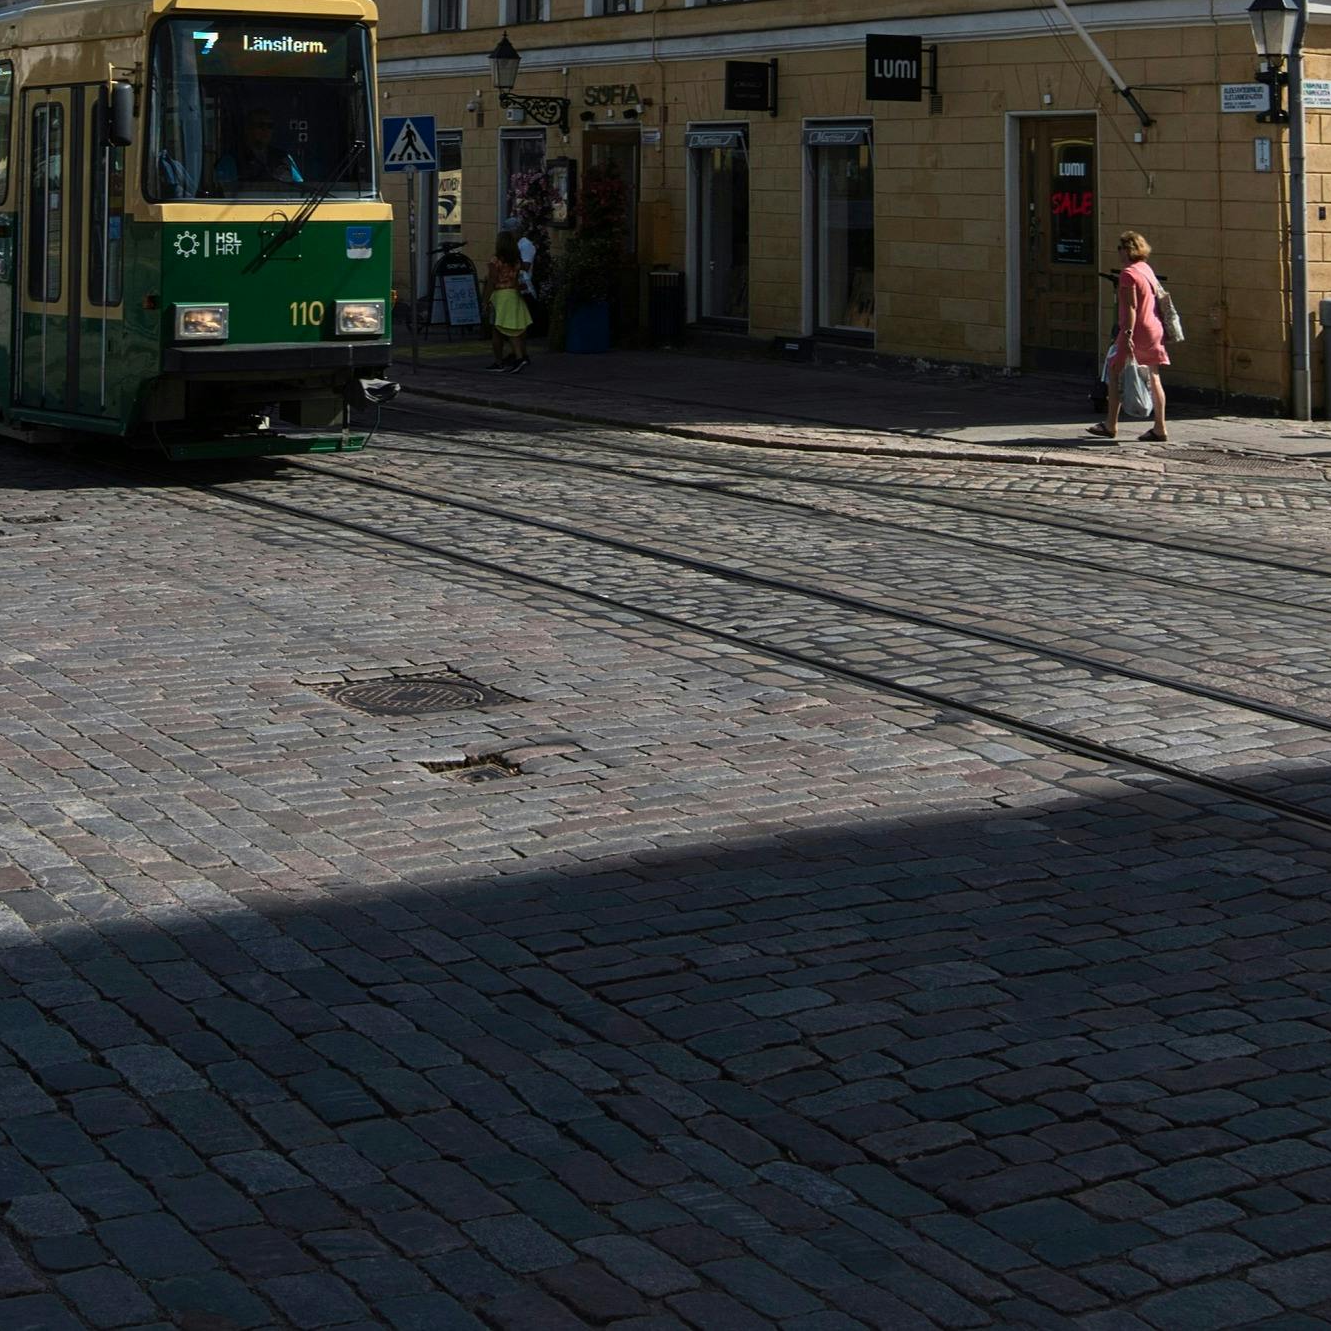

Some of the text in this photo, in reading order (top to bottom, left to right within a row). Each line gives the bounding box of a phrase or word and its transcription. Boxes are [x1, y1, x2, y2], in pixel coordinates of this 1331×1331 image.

[192, 31, 328, 55] 7 Länsiterm.
[874, 58, 917, 79] LUMI
[1059, 162, 1086, 177] LUMI
[1052, 190, 1094, 218] SALE
[215, 232, 242, 244] HSL
[215, 243, 242, 255] HRT
[290, 300, 325, 326] 110
